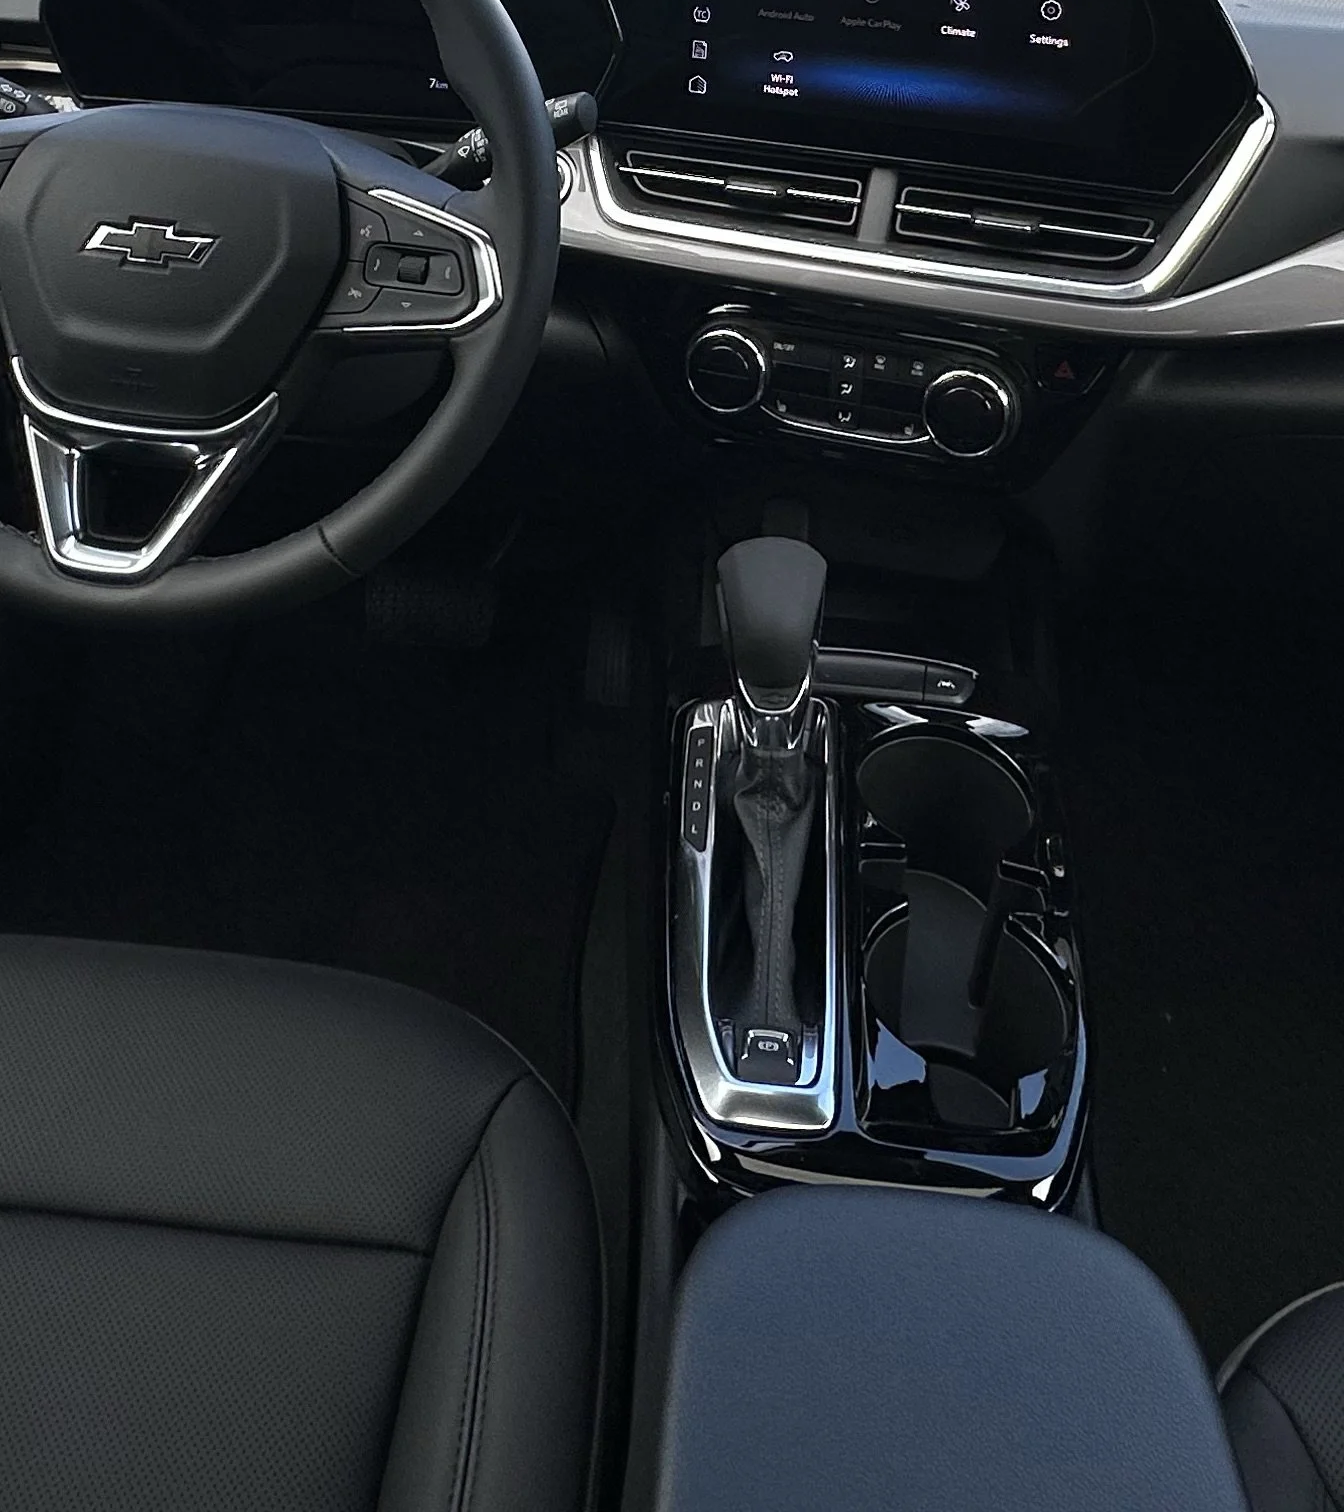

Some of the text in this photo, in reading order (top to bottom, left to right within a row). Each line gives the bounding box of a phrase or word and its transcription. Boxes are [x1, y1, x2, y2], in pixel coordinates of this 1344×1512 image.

[758, 8, 815, 22] Android Auto
[839, 15, 903, 31] Apple CarPlay
[940, 25, 977, 38] Climate
[1029, 33, 1069, 48] Settings
[770, 73, 794, 85] Wi-Fi
[763, 84, 800, 98] Hotspot
[697, 738, 705, 747] P
[695, 758, 704, 768] R
[693, 779, 703, 789] N
[692, 801, 701, 811] D
[691, 823, 698, 834] L
